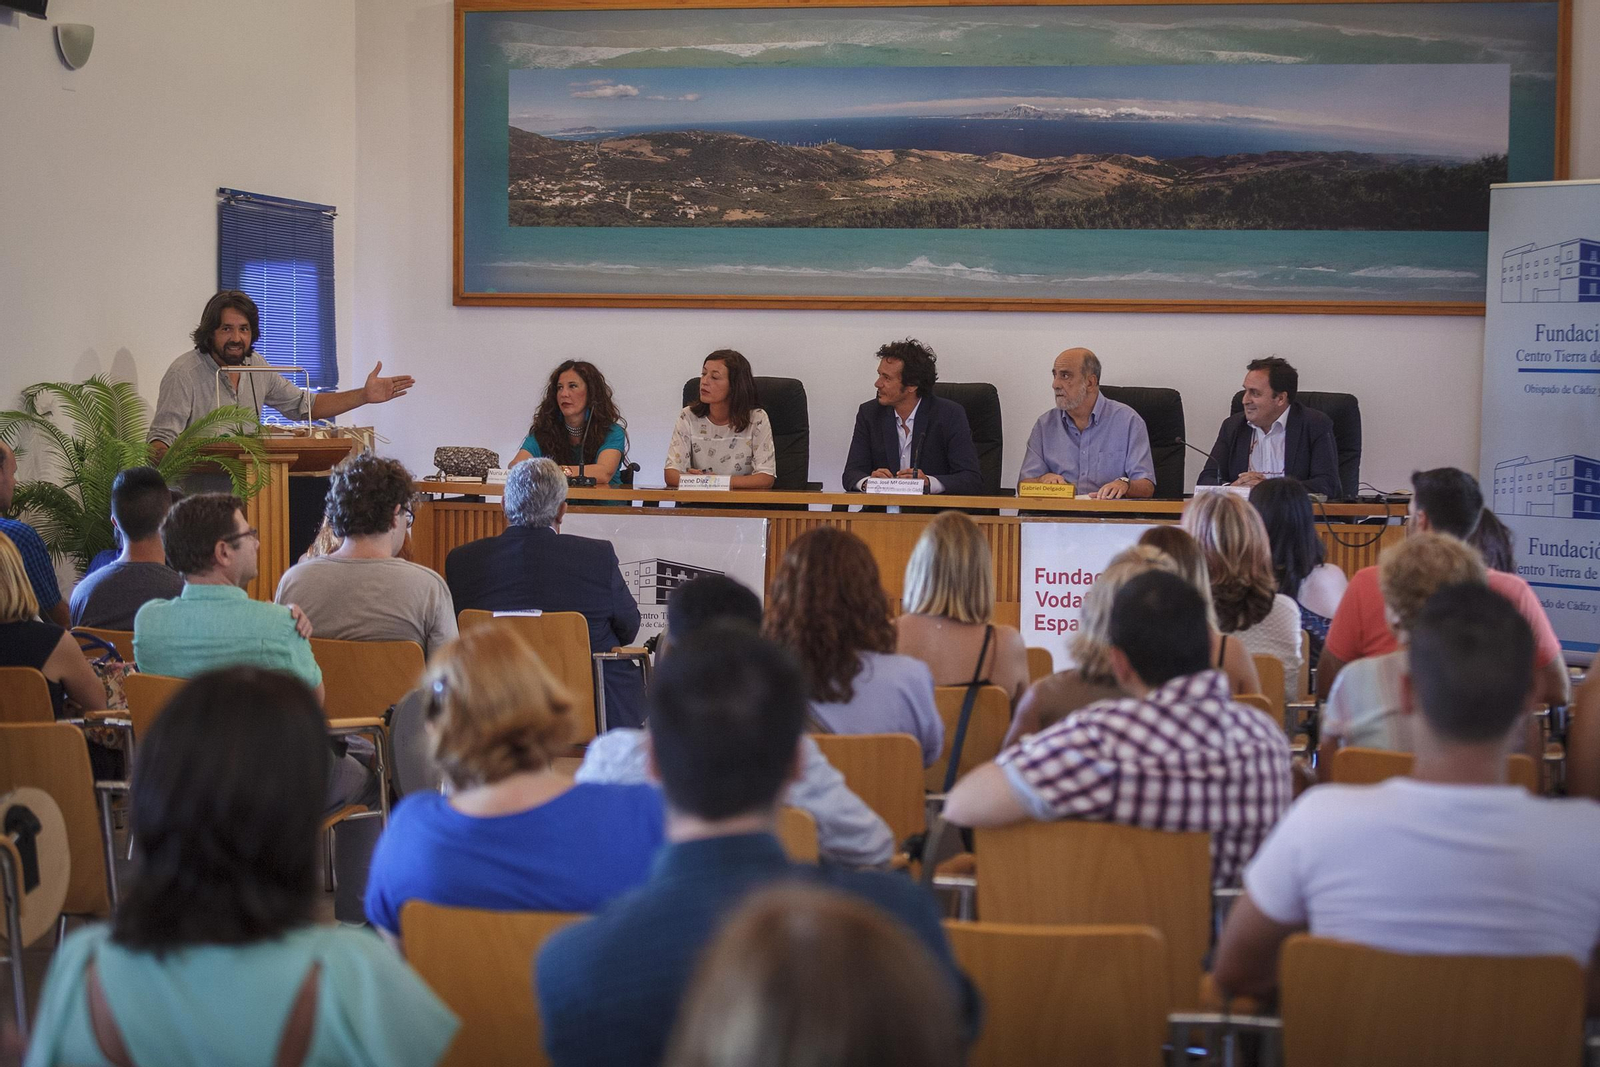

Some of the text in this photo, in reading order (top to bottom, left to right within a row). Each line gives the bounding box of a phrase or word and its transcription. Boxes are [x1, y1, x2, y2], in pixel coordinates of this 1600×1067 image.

[1535, 323, 1599, 342] Fundaci
[1516, 349, 1551, 362] Centro
[1554, 349, 1587, 362] Tierra
[1524, 384, 1559, 396] Obispado
[1562, 385, 1571, 394] de
[1572, 385, 1596, 395] Cádiz
[1528, 537, 1600, 560] Fundació
[1035, 568, 1102, 585] Fundac
[1517, 564, 1598, 580] entro Tierra de
[1035, 591, 1083, 608] Voda
[1555, 600, 1565, 609] de
[1567, 601, 1591, 611] Cádiz
[1592, 605, 1598, 614] y
[640, 612, 659, 620] entro
[1034, 614, 1079, 635] Espa
